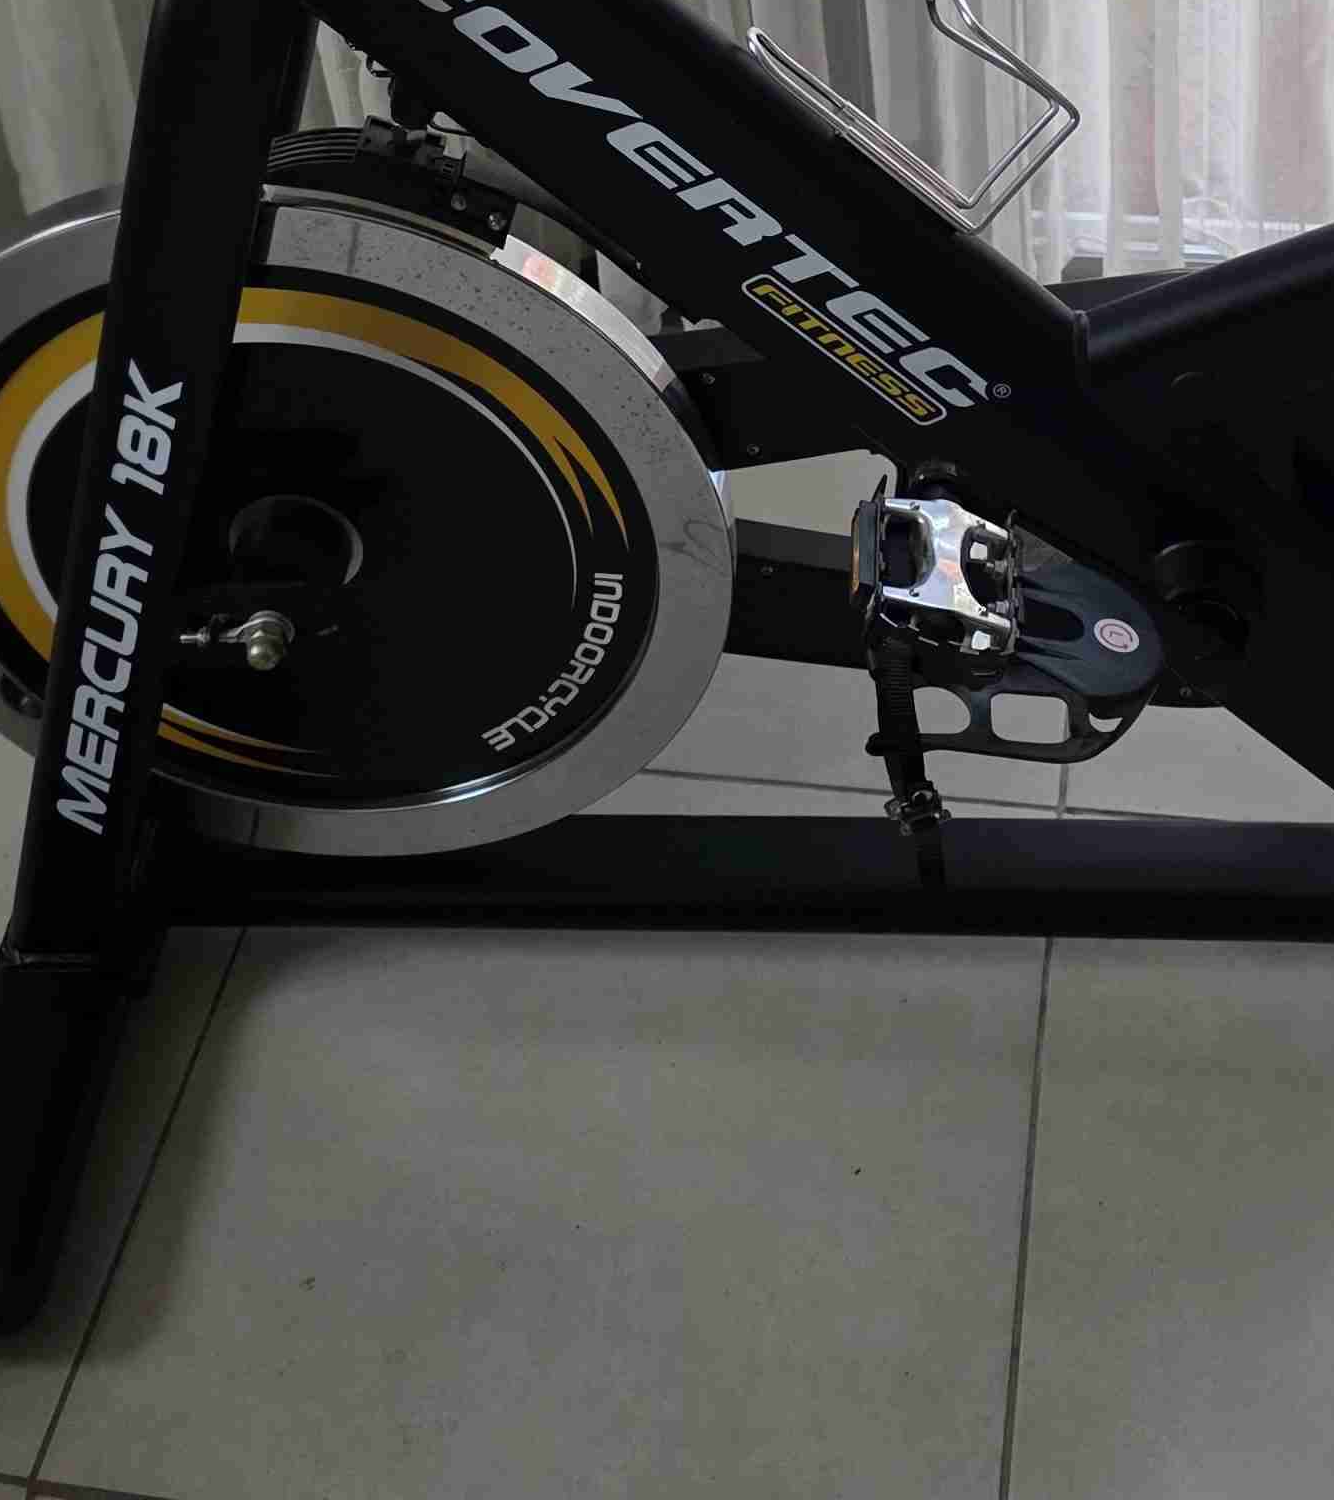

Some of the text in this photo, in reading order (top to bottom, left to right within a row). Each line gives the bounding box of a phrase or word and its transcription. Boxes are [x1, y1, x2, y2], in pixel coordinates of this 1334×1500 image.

[752, 284, 935, 416] FITNESS
[56, 358, 184, 835] MERCURY 18K
